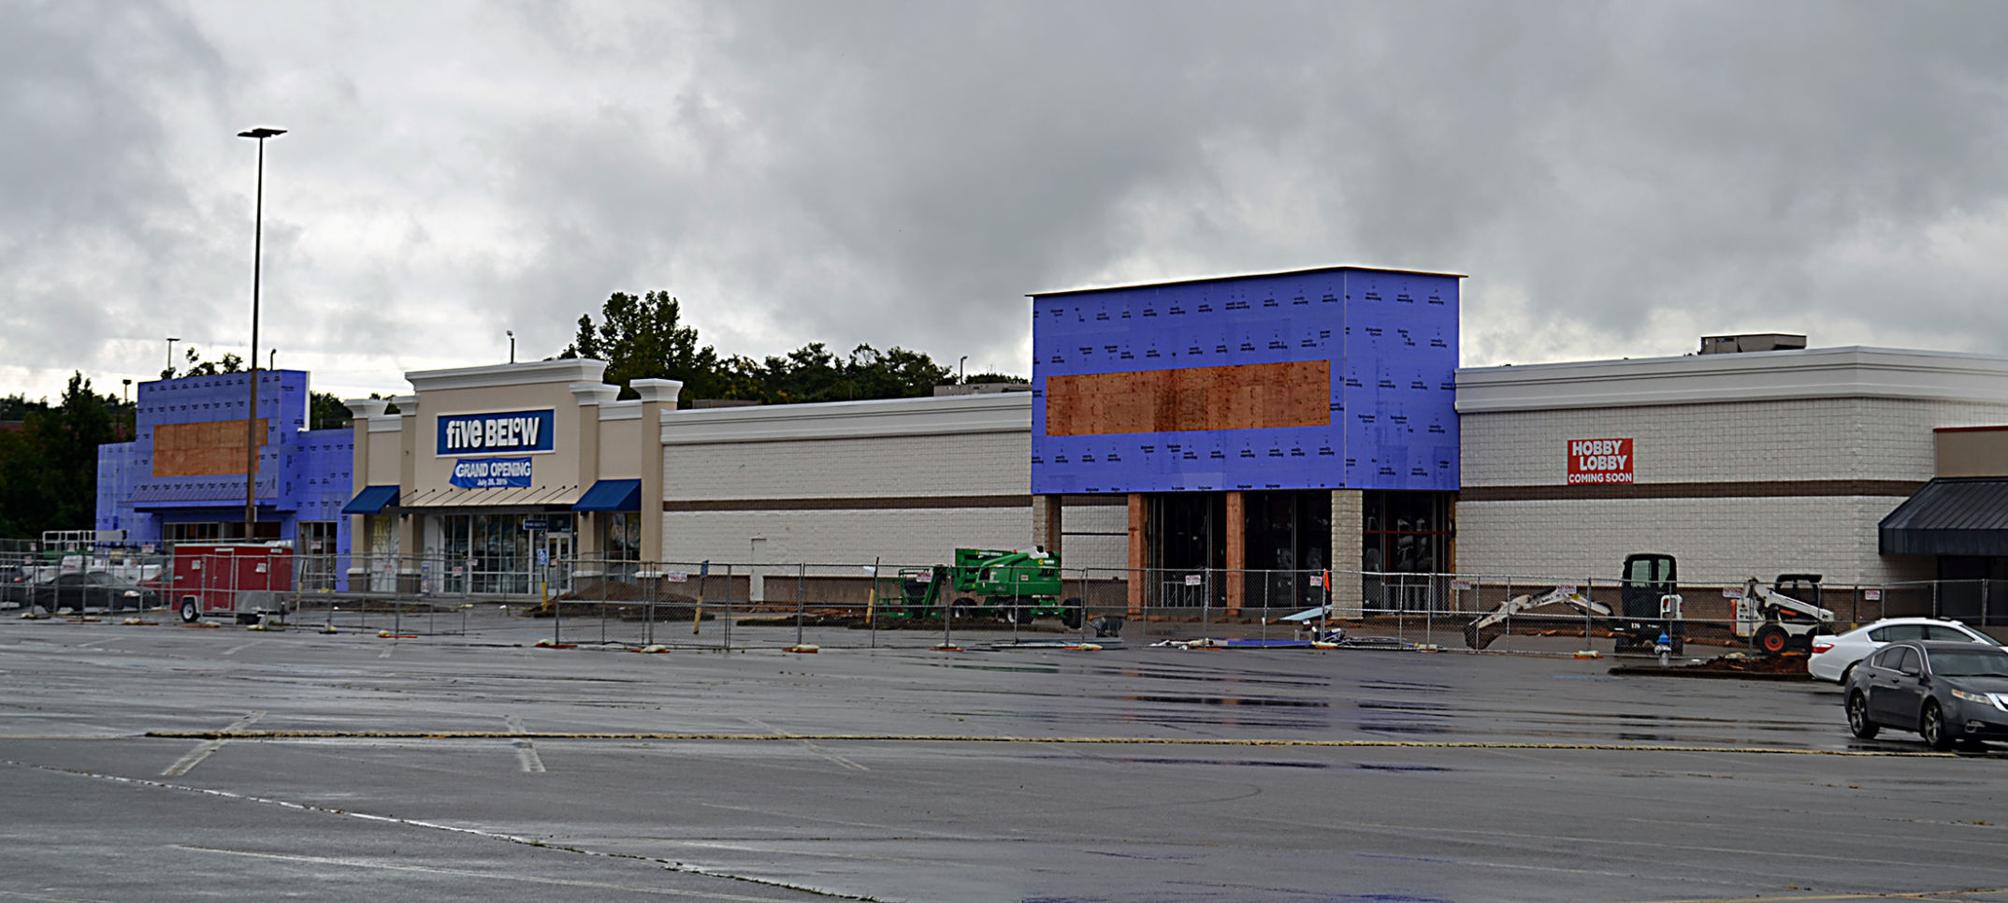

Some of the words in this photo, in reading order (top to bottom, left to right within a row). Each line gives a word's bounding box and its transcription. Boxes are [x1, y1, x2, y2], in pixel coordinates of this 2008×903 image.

[1572, 440, 1622, 456] HOBBY
[455, 463, 489, 478] GRAND
[490, 462, 531, 477] OPENING
[1580, 455, 1627, 471] LOBBY
[1569, 473, 1604, 483] COMING
[1605, 473, 1632, 482] SOON
